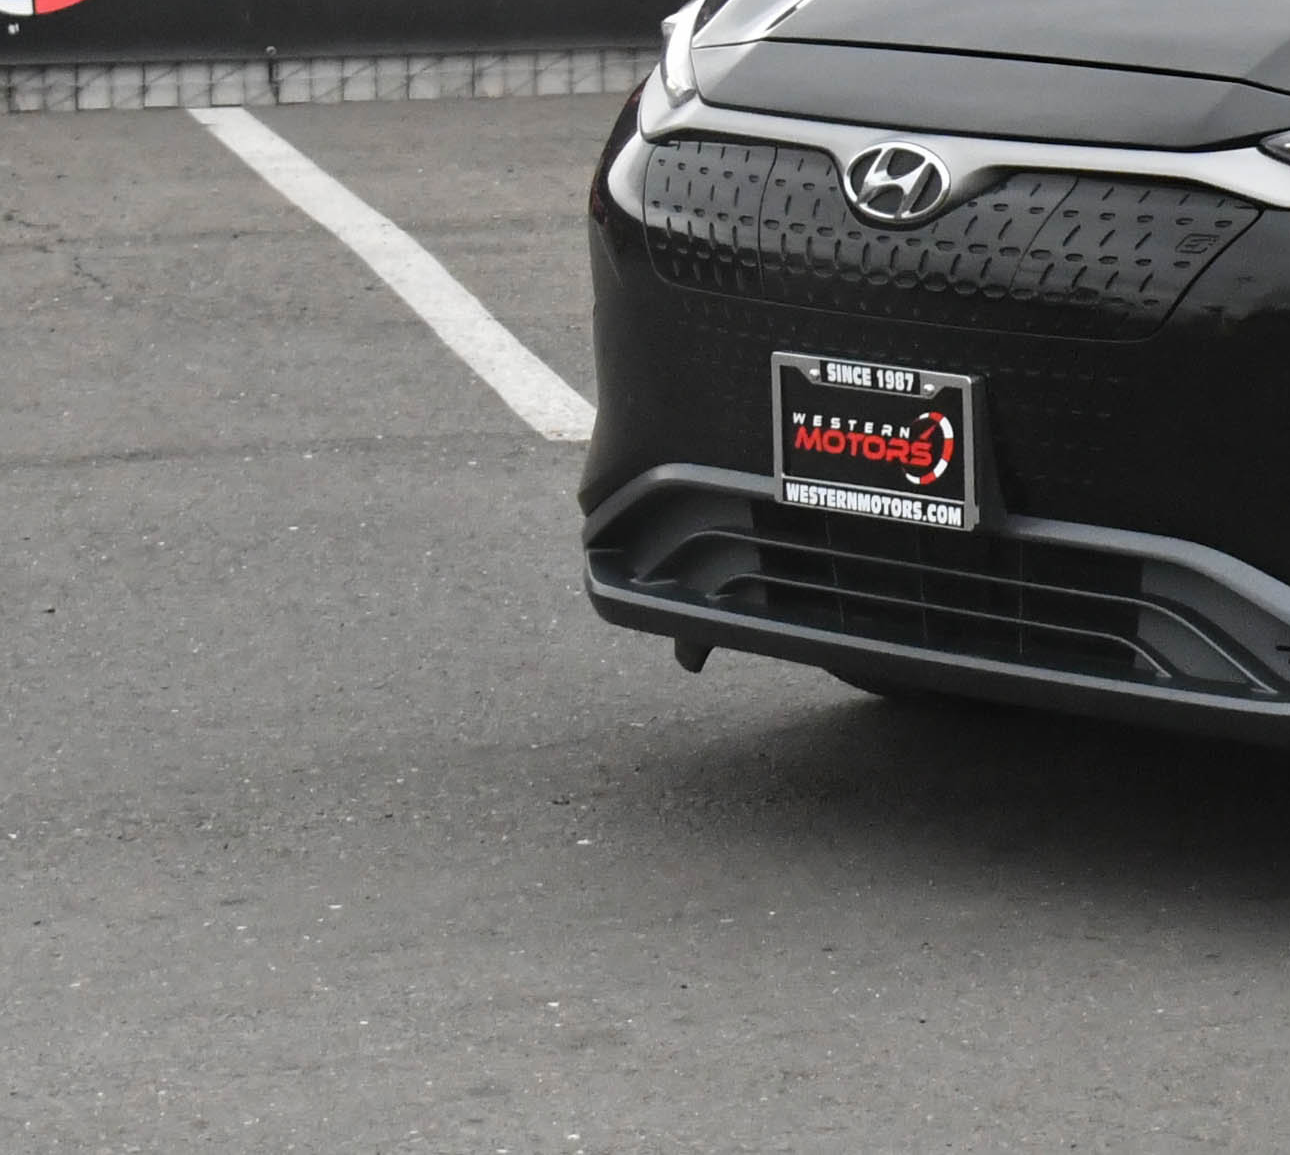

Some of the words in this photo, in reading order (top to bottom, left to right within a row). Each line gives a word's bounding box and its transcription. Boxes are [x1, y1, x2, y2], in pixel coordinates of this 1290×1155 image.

[826, 362, 872, 387] SINCE
[876, 370, 914, 392] 1987
[792, 411, 911, 439] WESTERN
[794, 425, 934, 468] MOTORS
[785, 481, 963, 527] WESTERNMOTORS.COM
